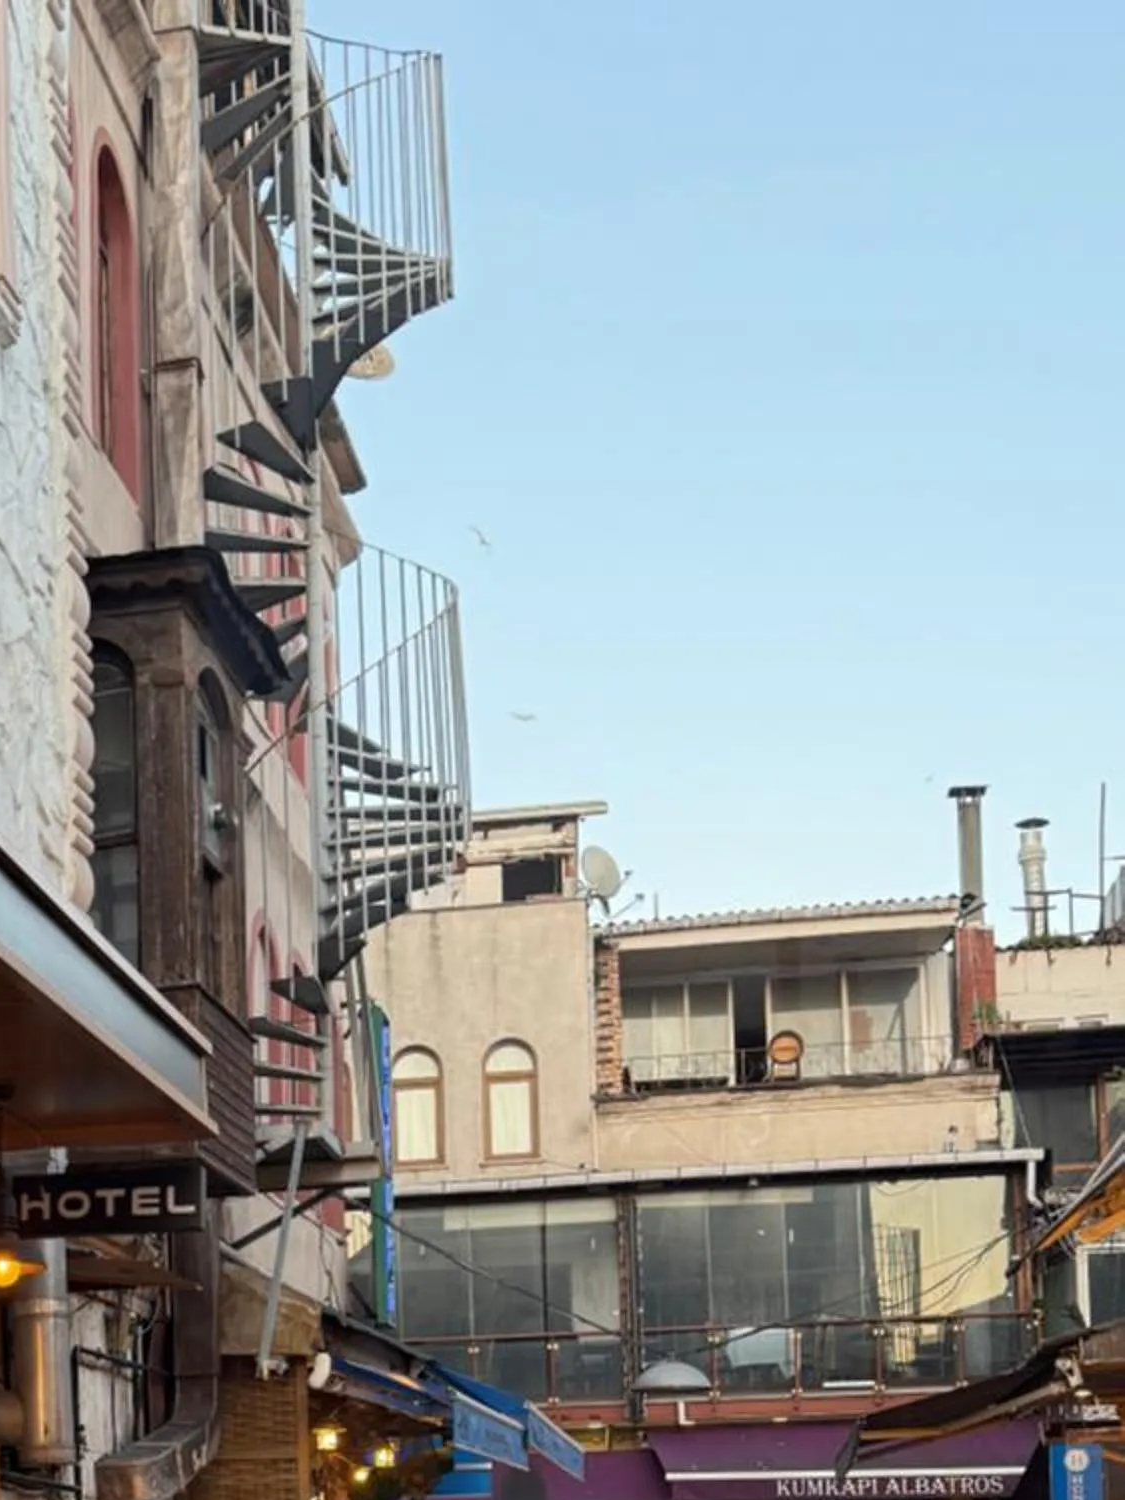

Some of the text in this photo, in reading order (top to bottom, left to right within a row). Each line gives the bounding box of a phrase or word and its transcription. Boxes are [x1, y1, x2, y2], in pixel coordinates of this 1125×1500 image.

[20, 1184, 196, 1221] HOTEL
[777, 1475, 1004, 1497] KUMKAPI ALBATROS
